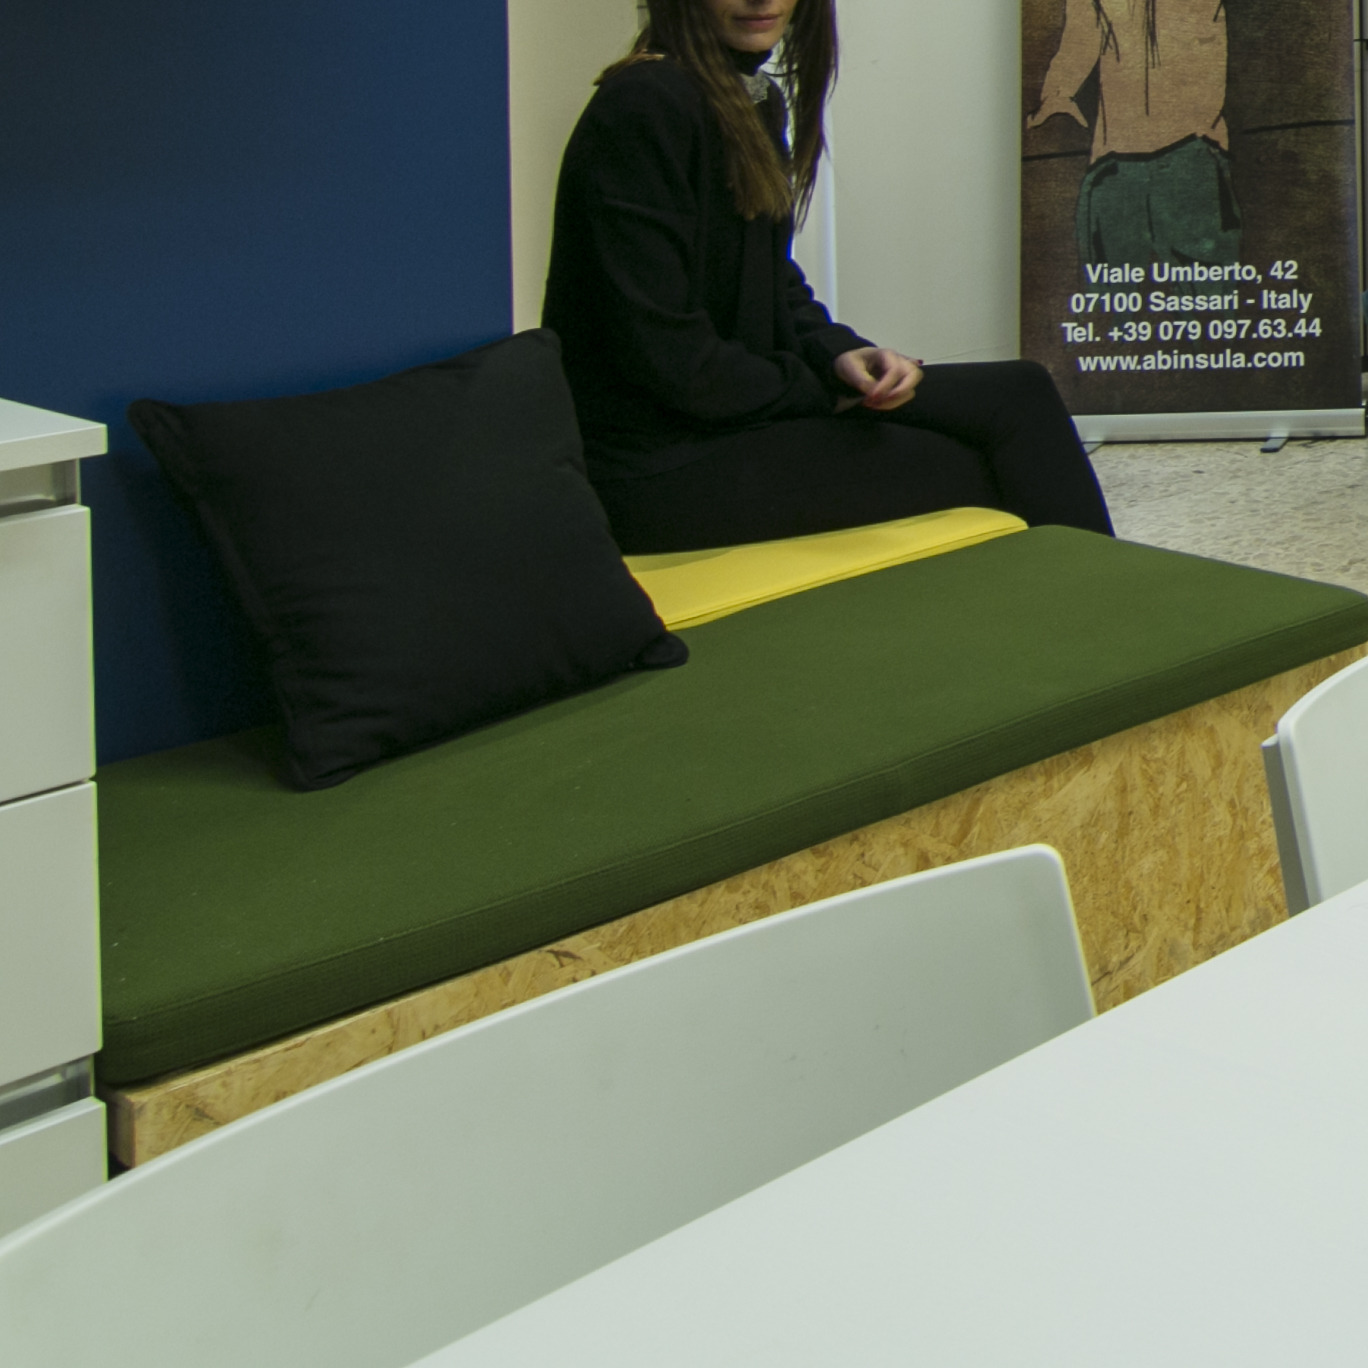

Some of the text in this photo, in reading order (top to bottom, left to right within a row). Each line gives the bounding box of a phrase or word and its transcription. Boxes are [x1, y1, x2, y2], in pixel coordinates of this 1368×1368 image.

[1086, 260, 1298, 285] Viale Umberto, 42
[1071, 293, 1143, 314] 07100
[1149, 290, 1239, 312] Sassari
[1262, 289, 1313, 314] Italy
[1061, 318, 1322, 343] Tel. +39 079 097.63.44
[1078, 349, 1305, 372] www.abinsula.com
